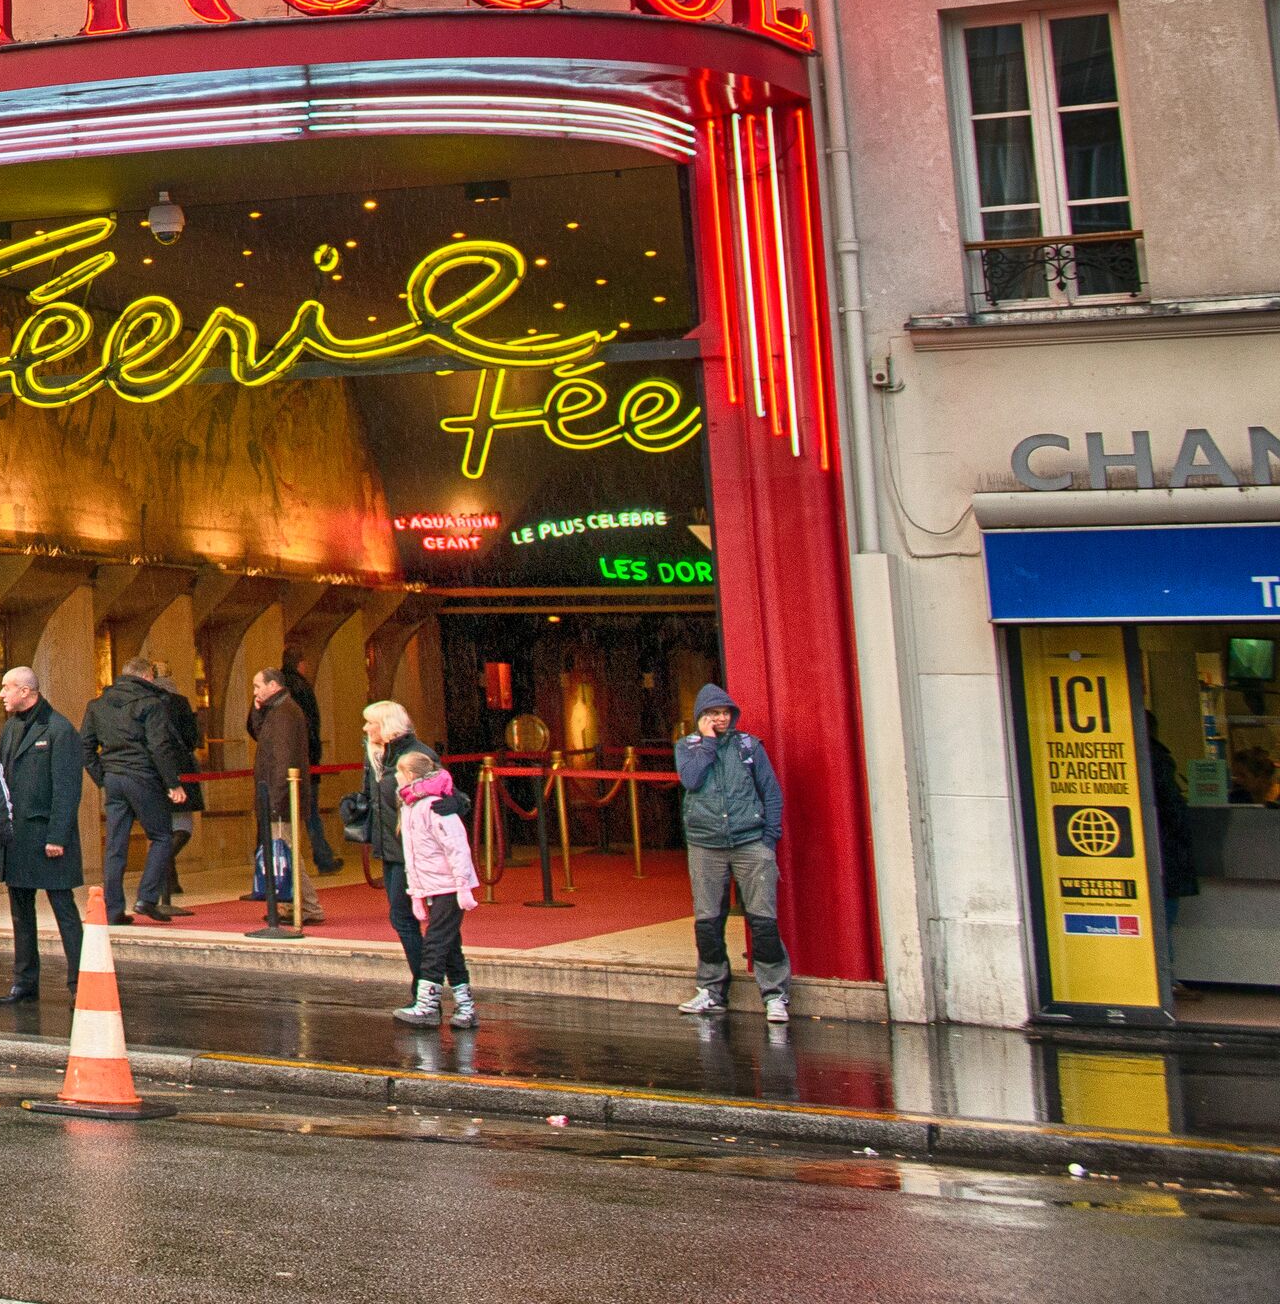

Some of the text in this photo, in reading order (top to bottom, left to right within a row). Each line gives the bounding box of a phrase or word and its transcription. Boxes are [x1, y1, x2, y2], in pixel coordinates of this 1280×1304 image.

[511, 527, 535, 545] LE
[538, 517, 585, 541] PLUS
[422, 535, 482, 551] GEANT
[597, 556, 648, 581] LES
[1049, 676, 1111, 733] ICI
[1046, 742, 1125, 758] TRANSFERT
[1048, 761, 1128, 780] D'ARGENT
[1051, 782, 1130, 794] DANS LE MONDE
[1061, 879, 1122, 888] WESTERN
[1081, 888, 1123, 897] UNION
